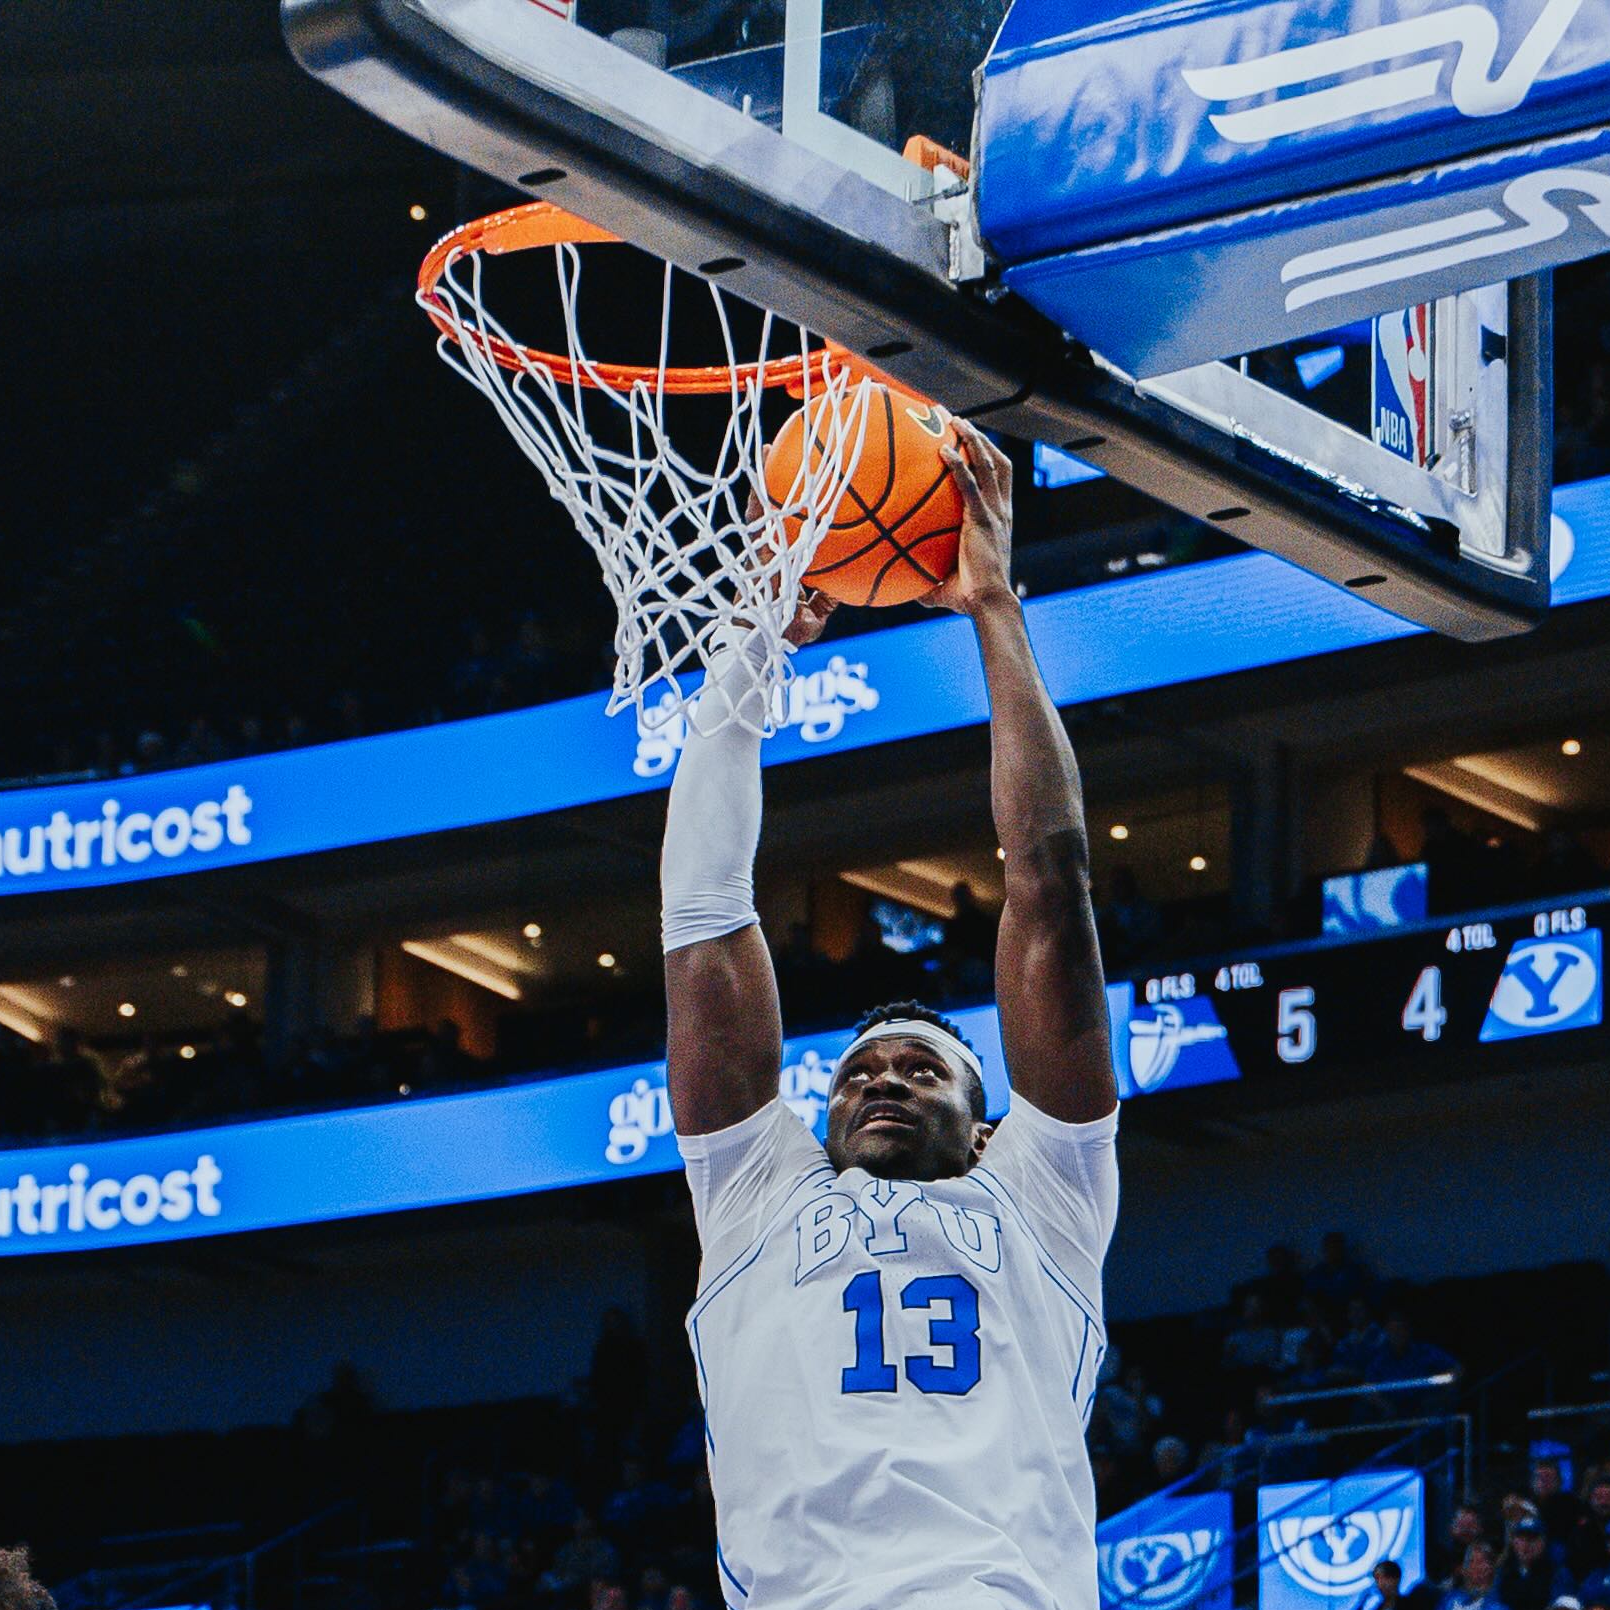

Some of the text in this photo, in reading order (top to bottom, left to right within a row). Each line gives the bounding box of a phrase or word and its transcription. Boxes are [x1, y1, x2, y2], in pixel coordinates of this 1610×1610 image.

[1380, 406, 1408, 453] NBA
[1446, 928, 1461, 953] 4
[1551, 907, 1586, 934] FLS
[1162, 973, 1195, 1000] FLS
[1215, 966, 1231, 992] 4
[1401, 965, 1448, 1042] 4
[1506, 951, 1580, 1019] Y
[1277, 986, 1317, 1064] 5
[795, 1179, 1002, 1286] BYU
[841, 1270, 982, 1396] 13
